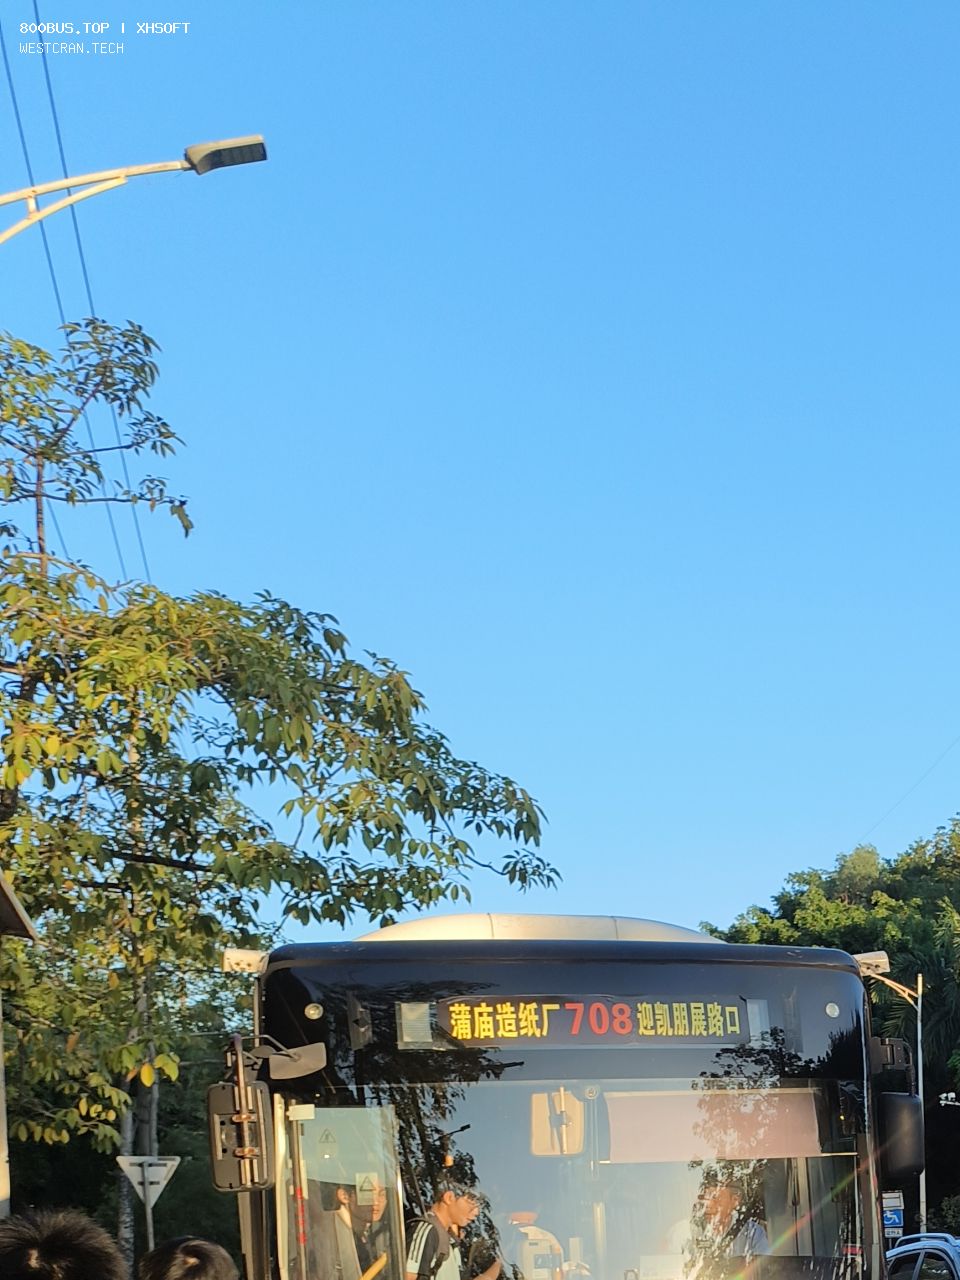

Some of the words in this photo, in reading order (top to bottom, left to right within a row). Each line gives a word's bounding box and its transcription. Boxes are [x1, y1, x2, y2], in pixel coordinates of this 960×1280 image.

[449, 1002, 560, 1039] 蒲庙造纸厂
[564, 1002, 633, 1035] 708
[636, 1002, 741, 1037] 迎凯朋展路口
